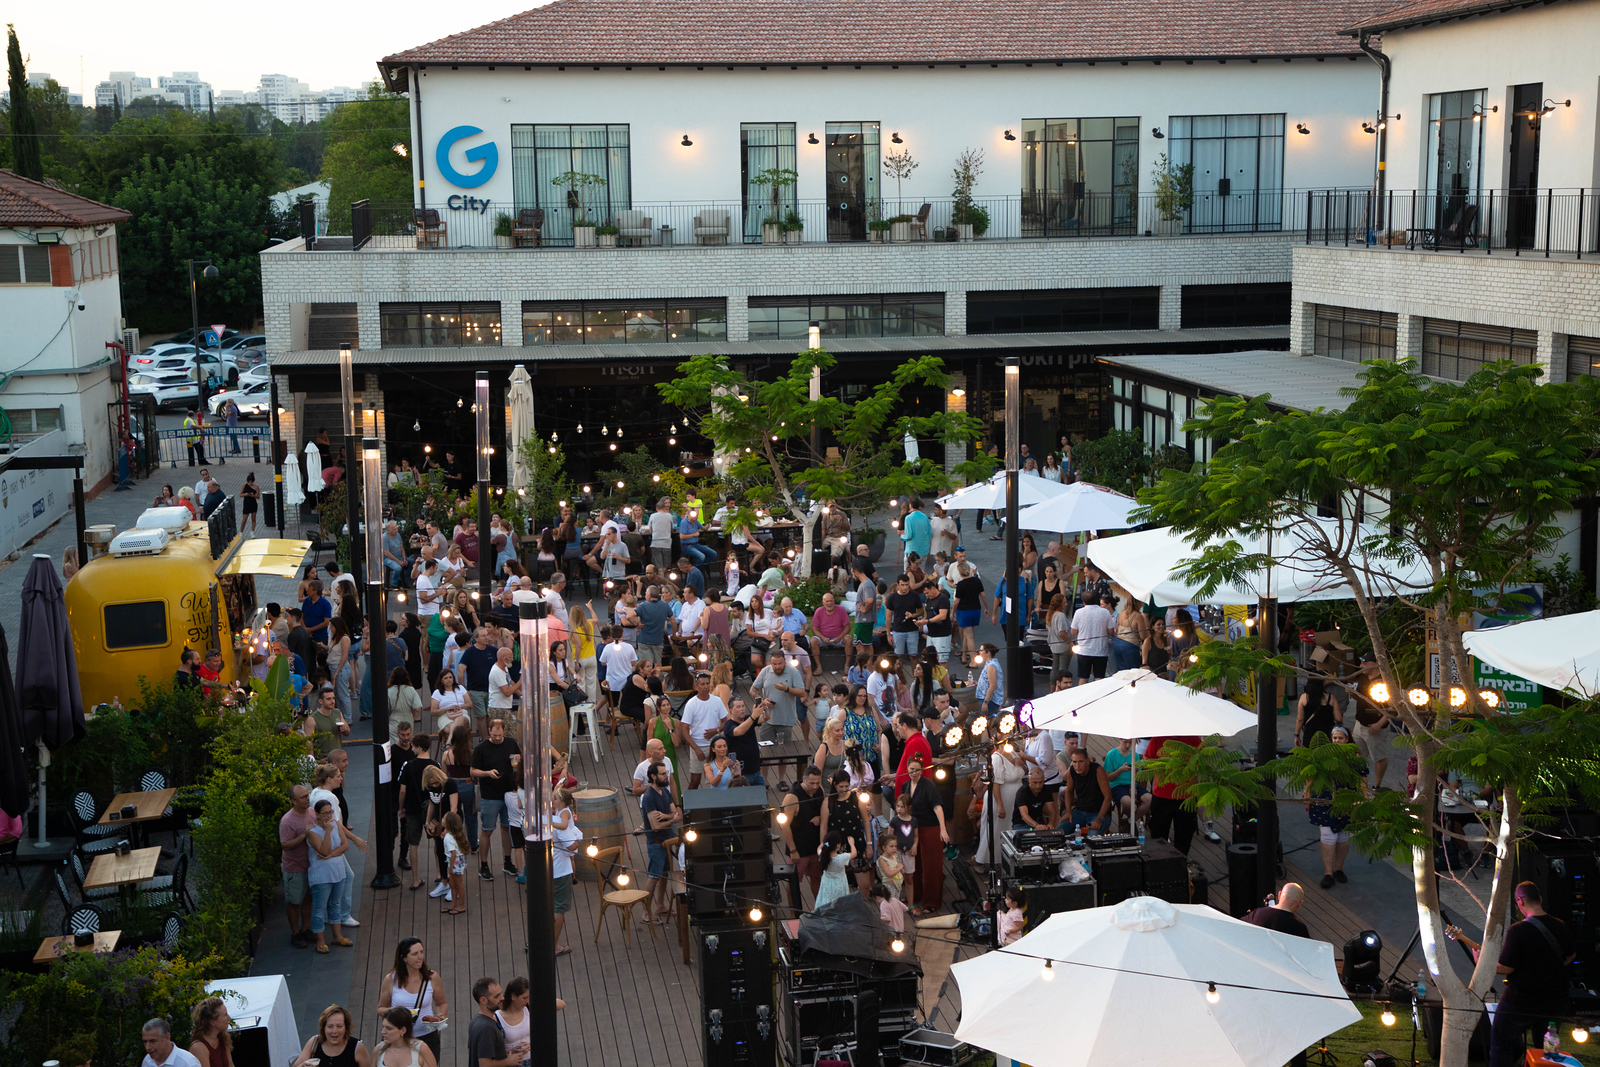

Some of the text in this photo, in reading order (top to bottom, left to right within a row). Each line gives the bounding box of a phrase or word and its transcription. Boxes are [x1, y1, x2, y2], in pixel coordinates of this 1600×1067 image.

[436, 125, 499, 189] G
[447, 194, 491, 215] City
[187, 621, 228, 643] gysy
